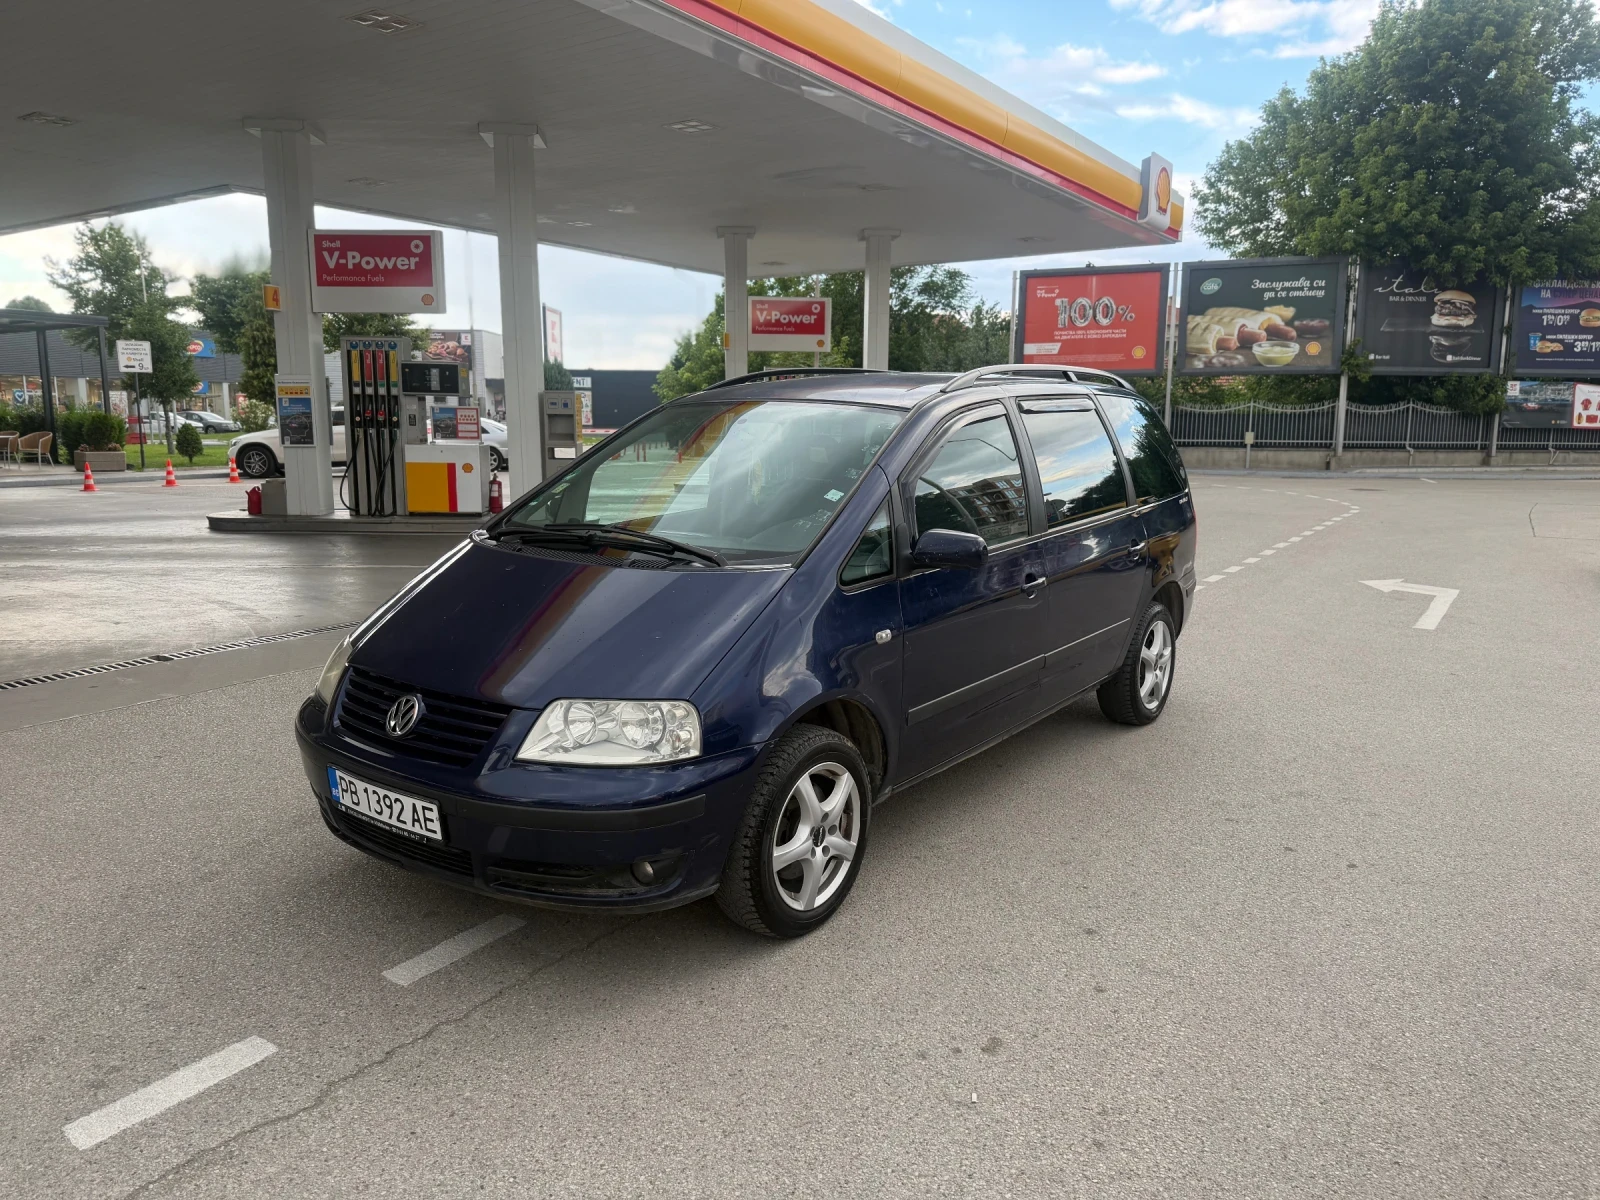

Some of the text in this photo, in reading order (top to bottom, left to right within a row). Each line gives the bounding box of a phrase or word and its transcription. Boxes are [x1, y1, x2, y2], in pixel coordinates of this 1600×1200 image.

[322, 239, 341, 248] Shell
[321, 250, 420, 270] V-Power
[322, 273, 385, 282] Performance Fuels
[1251, 276, 1327, 293] Заслужава си
[1263, 287, 1325, 301] да се отбиеш
[1540, 289, 1551, 298] НА
[755, 310, 818, 325] V-Power
[138, 362, 144, 370] 9
